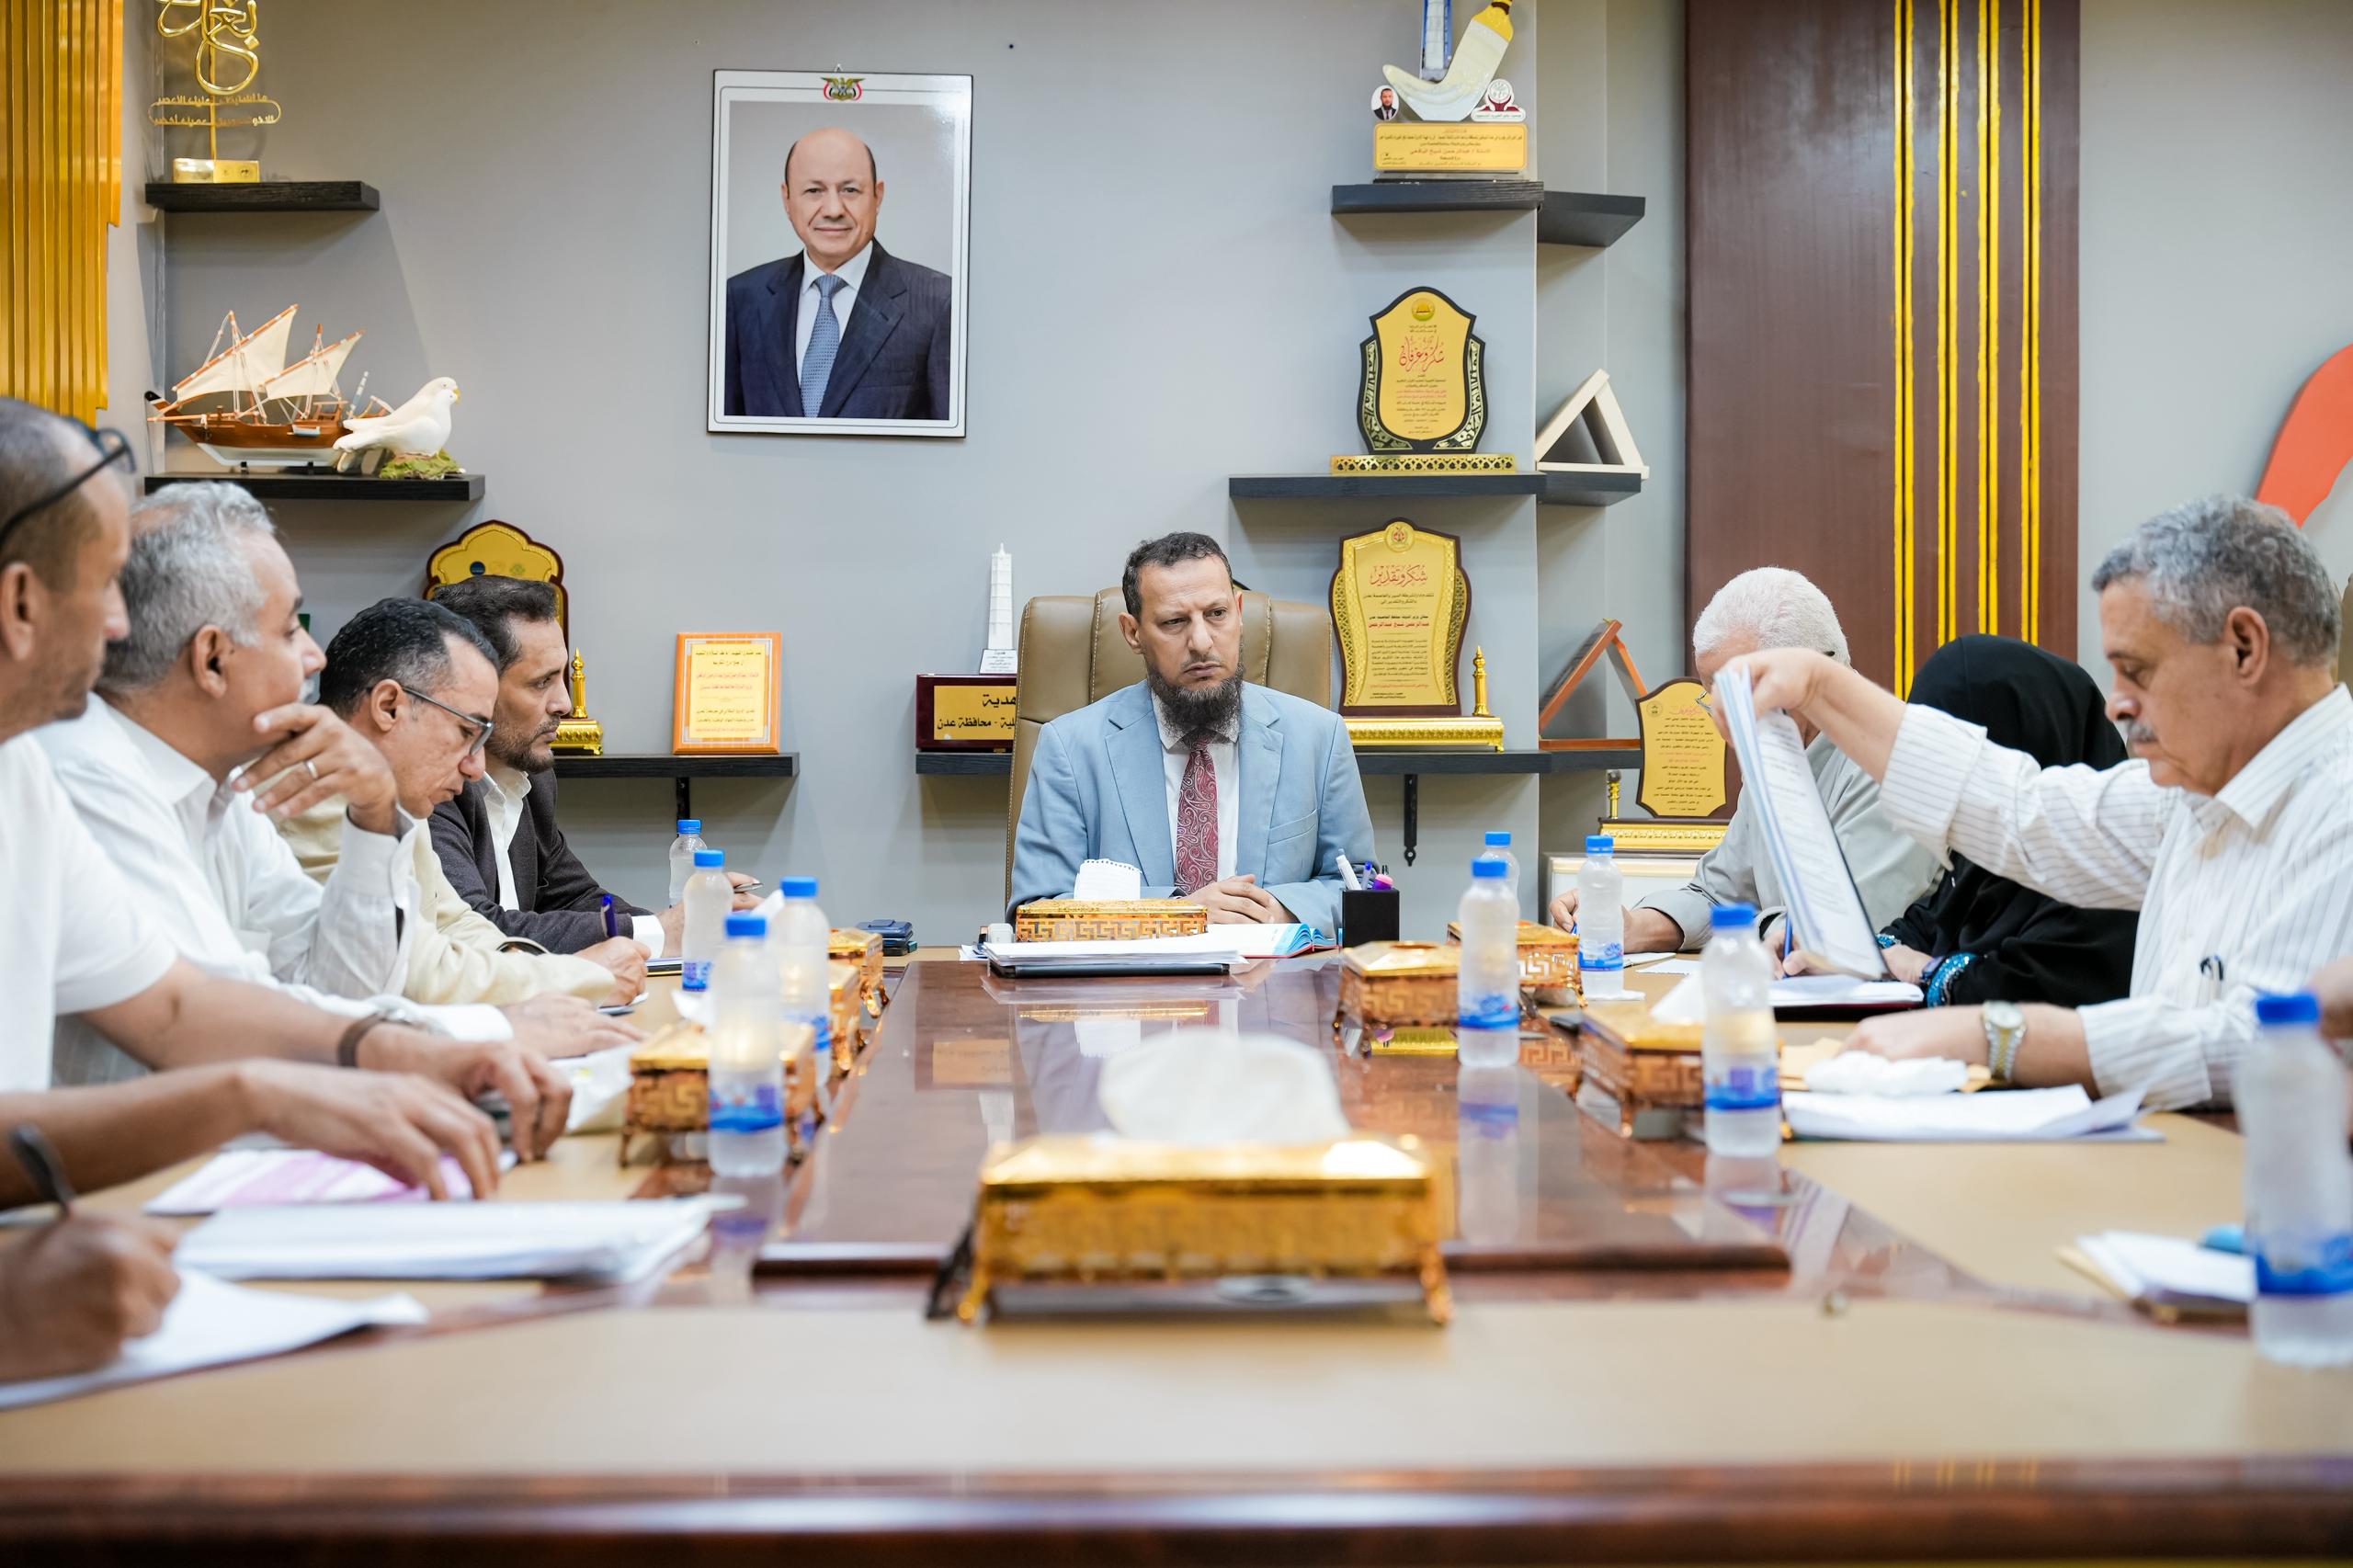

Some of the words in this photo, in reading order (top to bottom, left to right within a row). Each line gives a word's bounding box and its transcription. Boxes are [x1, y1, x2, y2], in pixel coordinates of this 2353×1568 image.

[1370, 565, 1405, 586] وتقدير
[1401, 564, 1427, 588] شكر
[937, 719, 956, 729] عدن
[958, 717, 992, 728] محافظة
